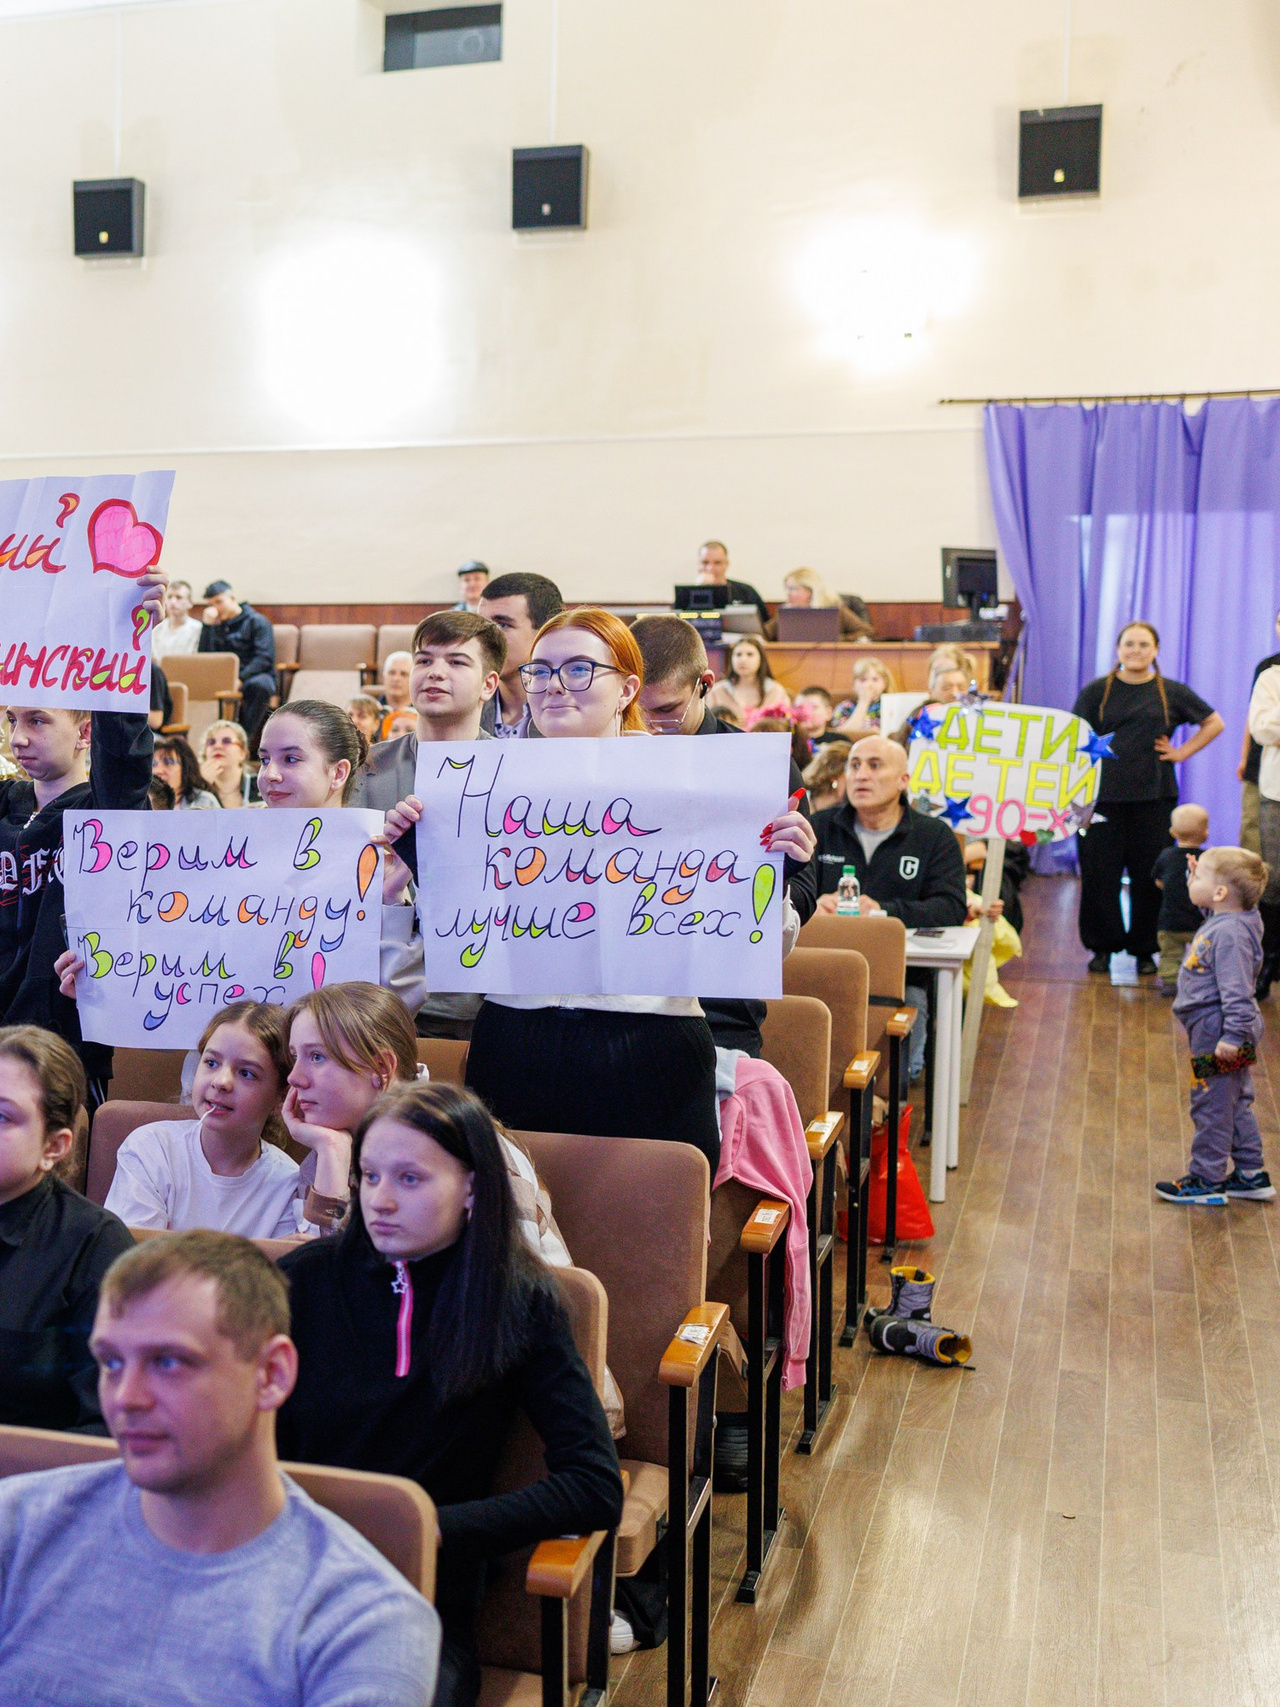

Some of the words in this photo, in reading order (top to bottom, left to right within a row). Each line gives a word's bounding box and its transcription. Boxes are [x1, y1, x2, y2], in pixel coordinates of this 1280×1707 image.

[936, 706, 1080, 763] ДЕТИ
[436, 753, 662, 838] Наша
[72, 818, 258, 892] Верим
[482, 844, 751, 905] команда
[126, 843, 379, 953] команду!
[77, 931, 236, 997] Верим
[435, 901, 596, 968] лучше
